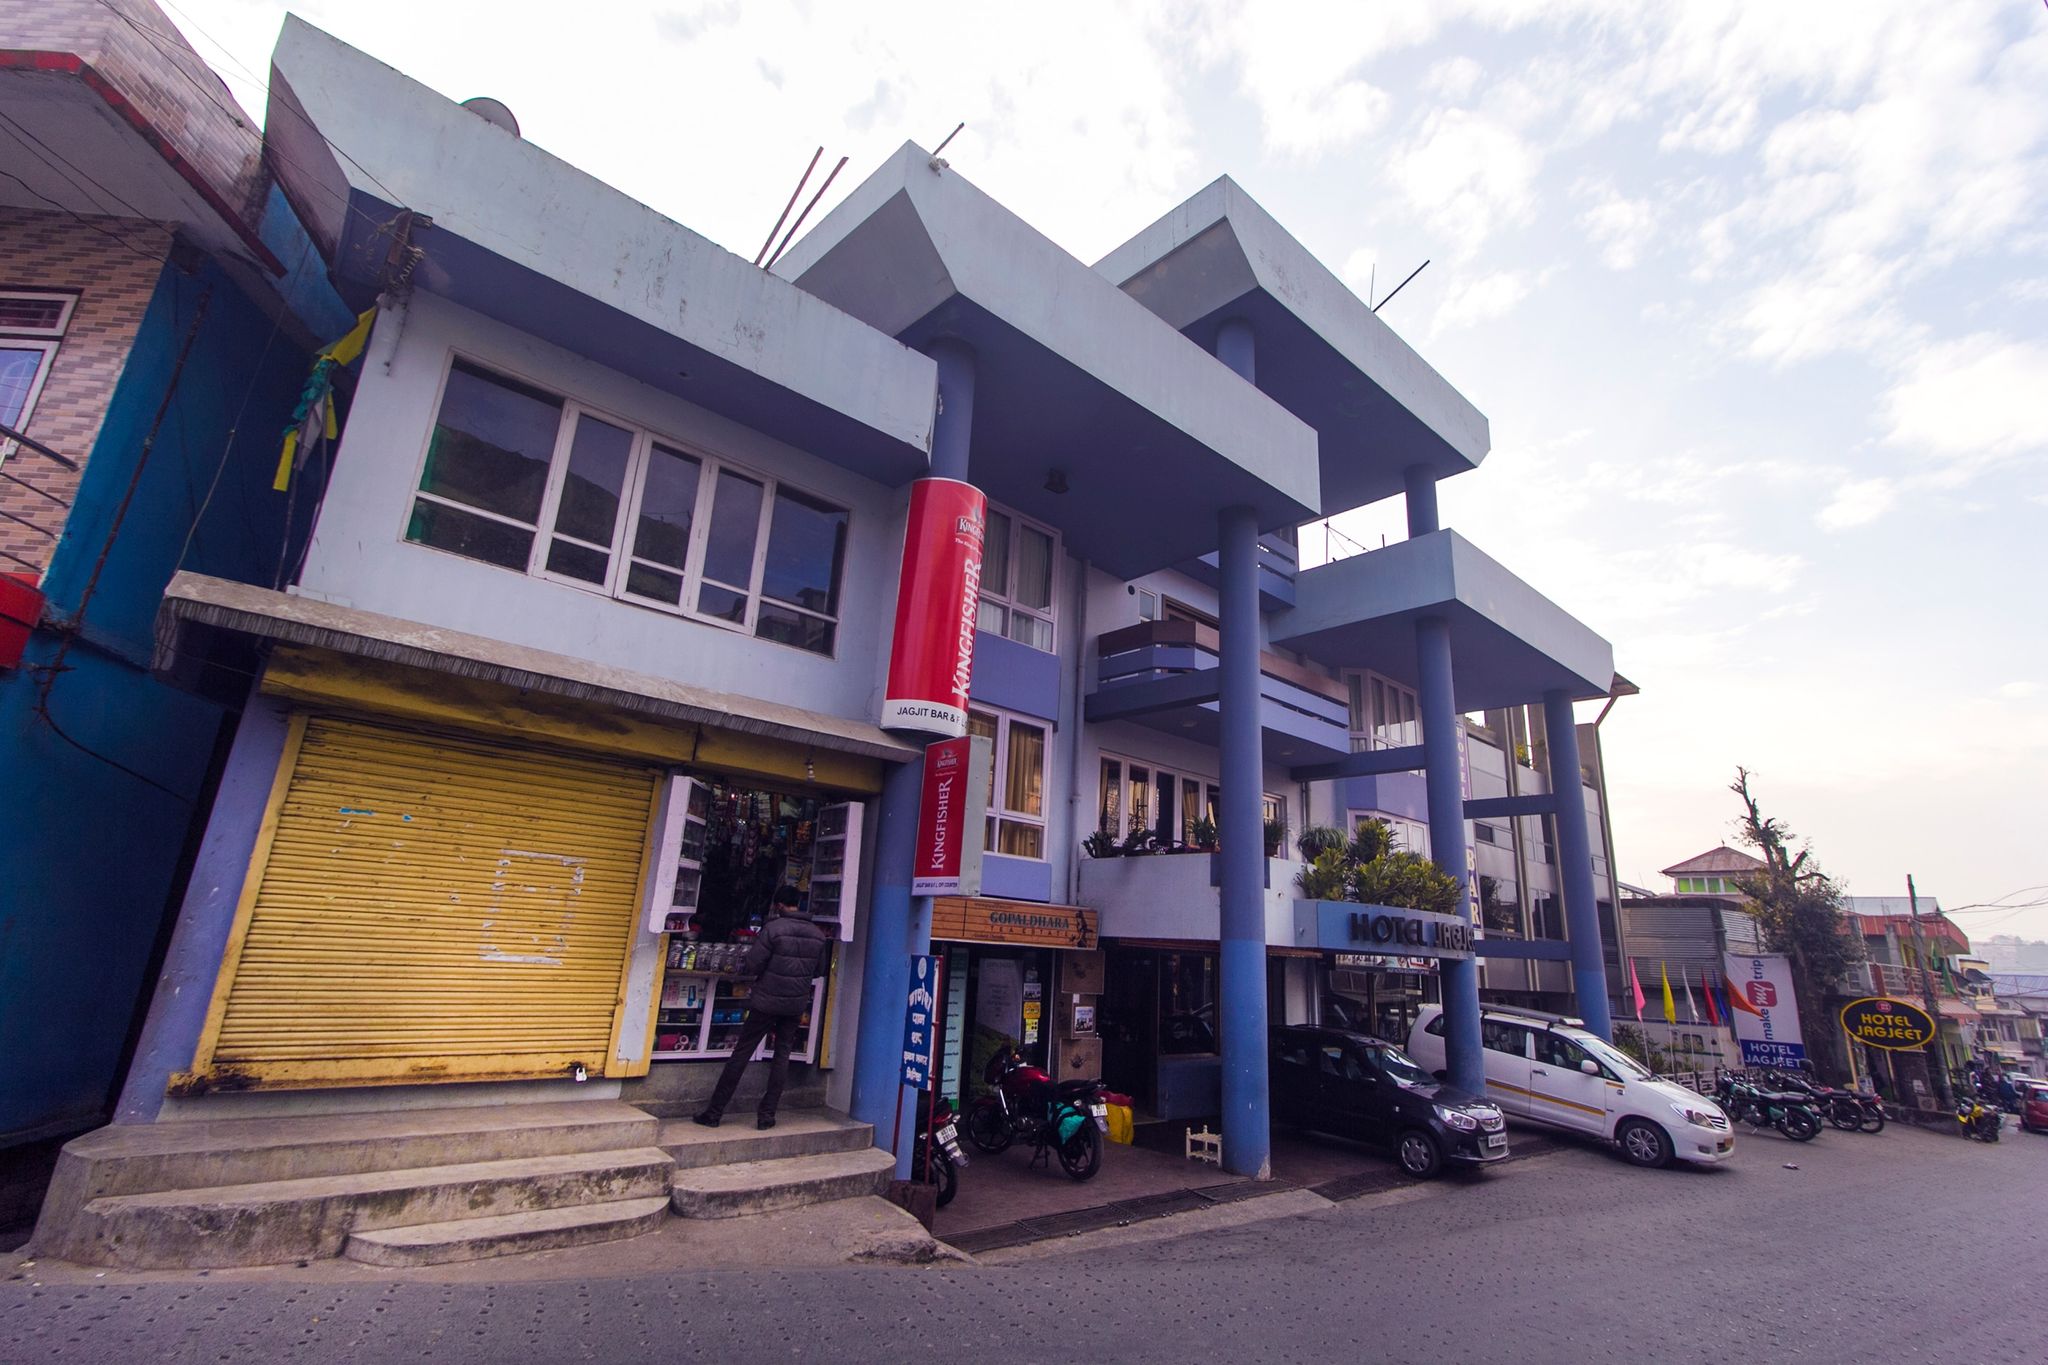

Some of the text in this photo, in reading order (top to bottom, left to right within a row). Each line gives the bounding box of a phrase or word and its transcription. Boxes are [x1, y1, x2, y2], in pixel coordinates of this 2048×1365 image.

[951, 558, 982, 700] KINGFISHER
[897, 707, 929, 717] JAGJIT
[931, 709, 949, 720] BAR
[931, 776, 953, 870] KINGFISHER
[989, 912, 1070, 929] GOPALDHARA
[1350, 913, 1428, 946] HOTEL
[1751, 959, 1765, 980] trip
[1760, 1008, 1773, 1040] make
[1861, 1013, 1913, 1028] HOTEL
[1857, 1025, 1922, 1041] JAGJEET
[1750, 1042, 1796, 1056] HOTEL
